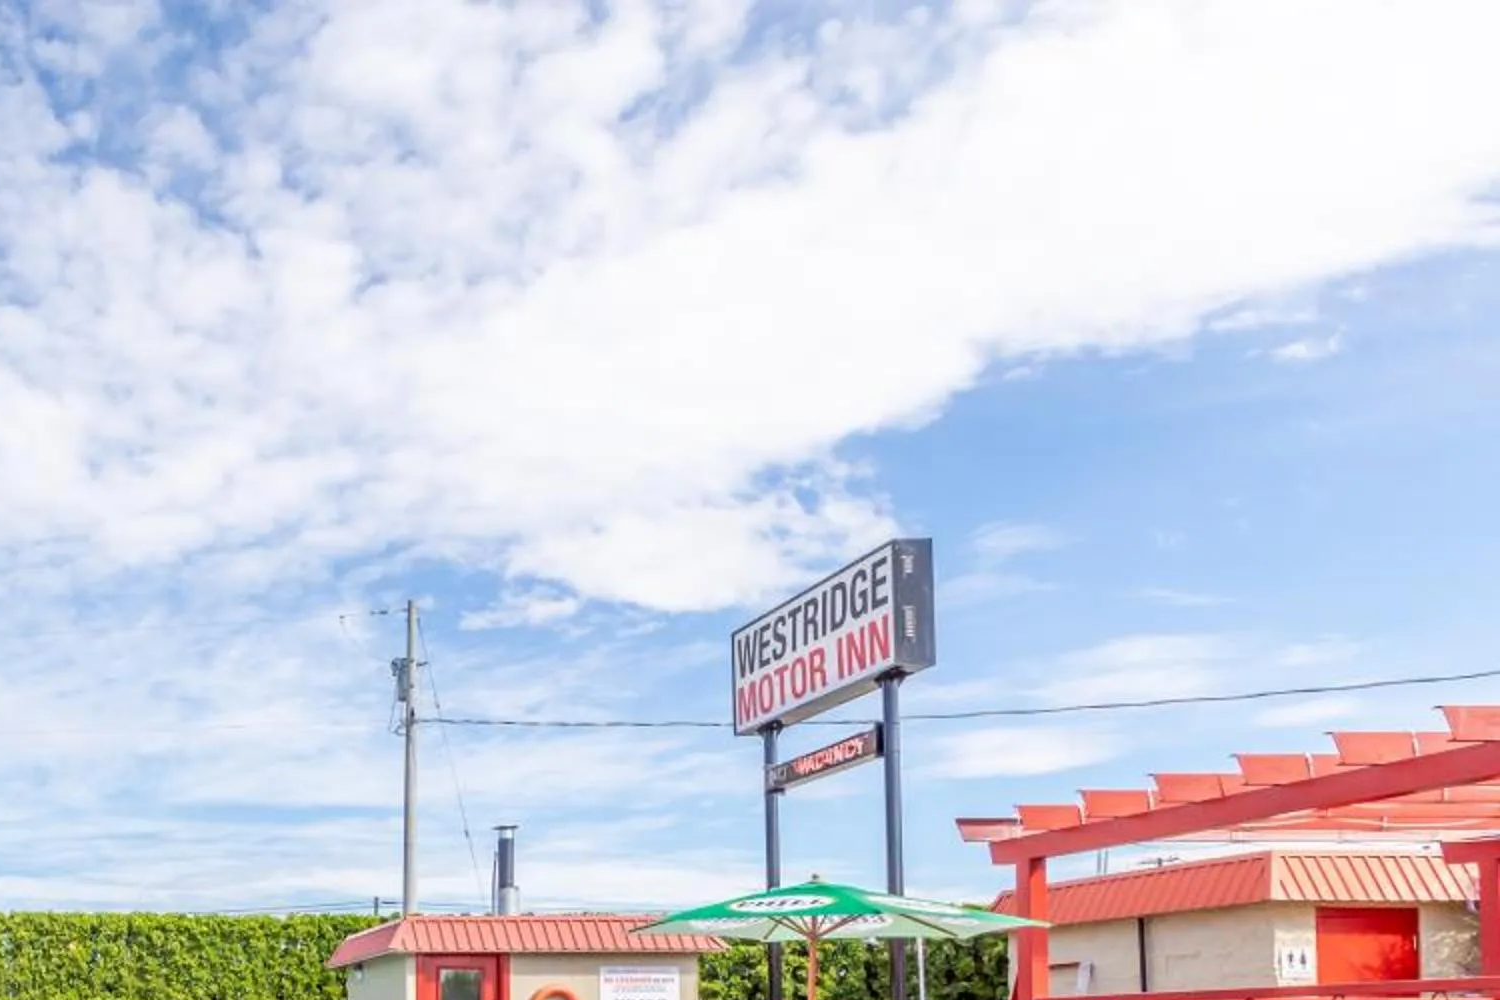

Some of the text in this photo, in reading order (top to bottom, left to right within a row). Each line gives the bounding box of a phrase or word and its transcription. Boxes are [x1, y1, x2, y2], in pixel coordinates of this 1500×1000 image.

[738, 556, 888, 677] WESTRIDGE
[738, 647, 827, 725] MOTOR
[837, 613, 890, 679] INN
[794, 736, 865, 774] VACANCY
